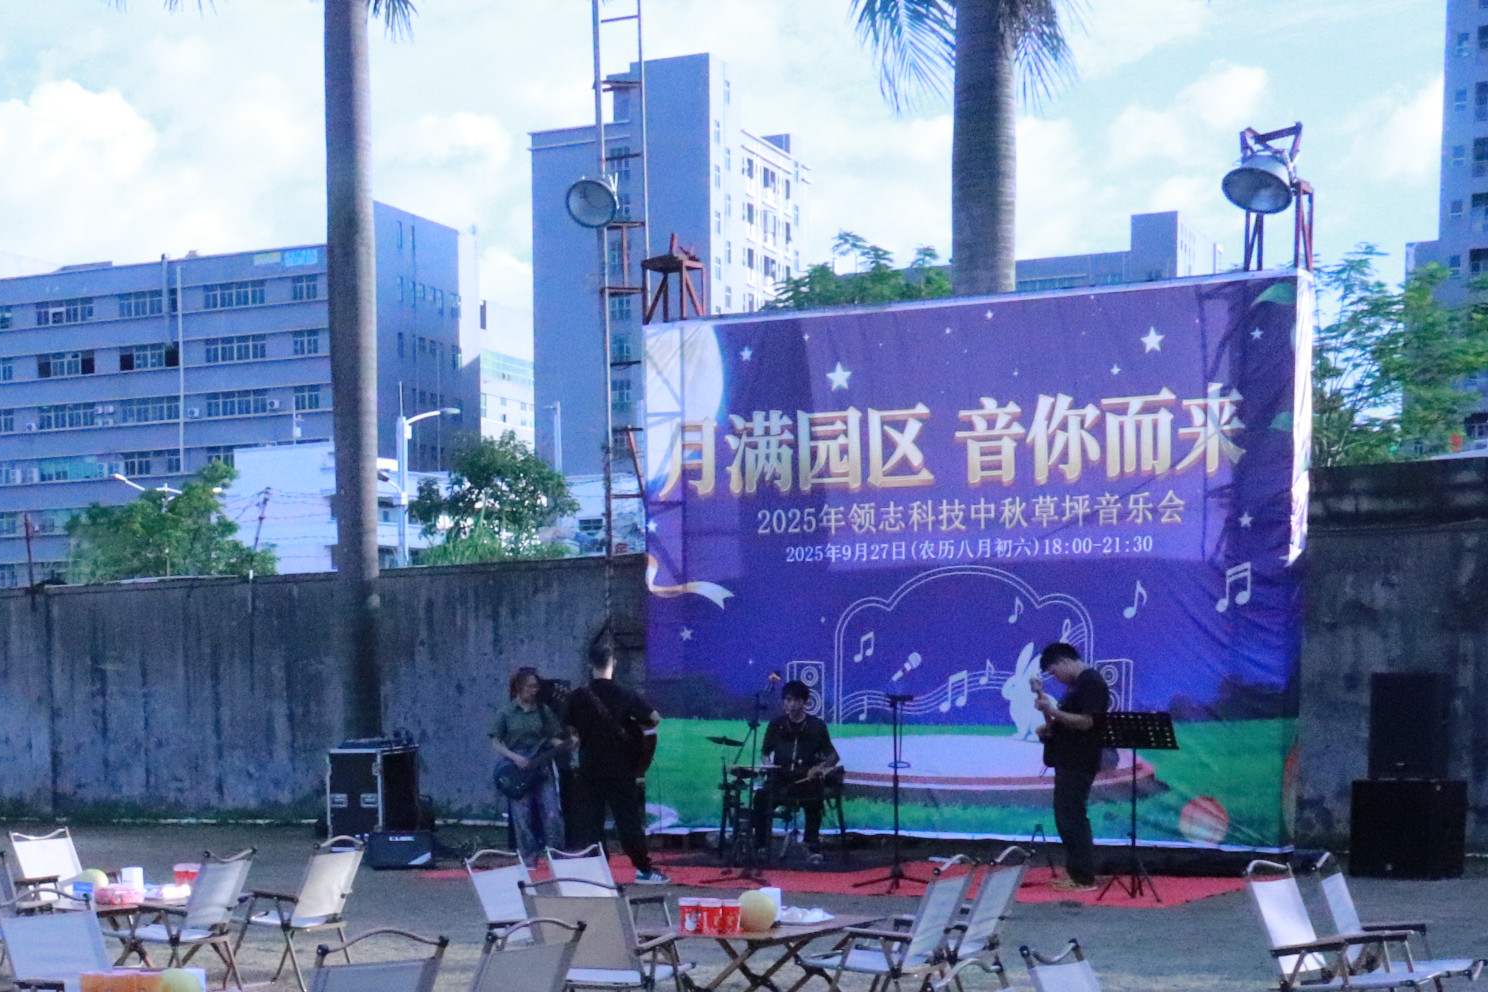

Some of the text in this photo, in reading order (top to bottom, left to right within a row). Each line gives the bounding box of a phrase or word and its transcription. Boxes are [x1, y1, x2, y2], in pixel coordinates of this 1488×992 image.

[659, 382, 1247, 500] 月满园区 音你而来
[757, 490, 1186, 535] 2025年领志科技中秋草坪音乐会
